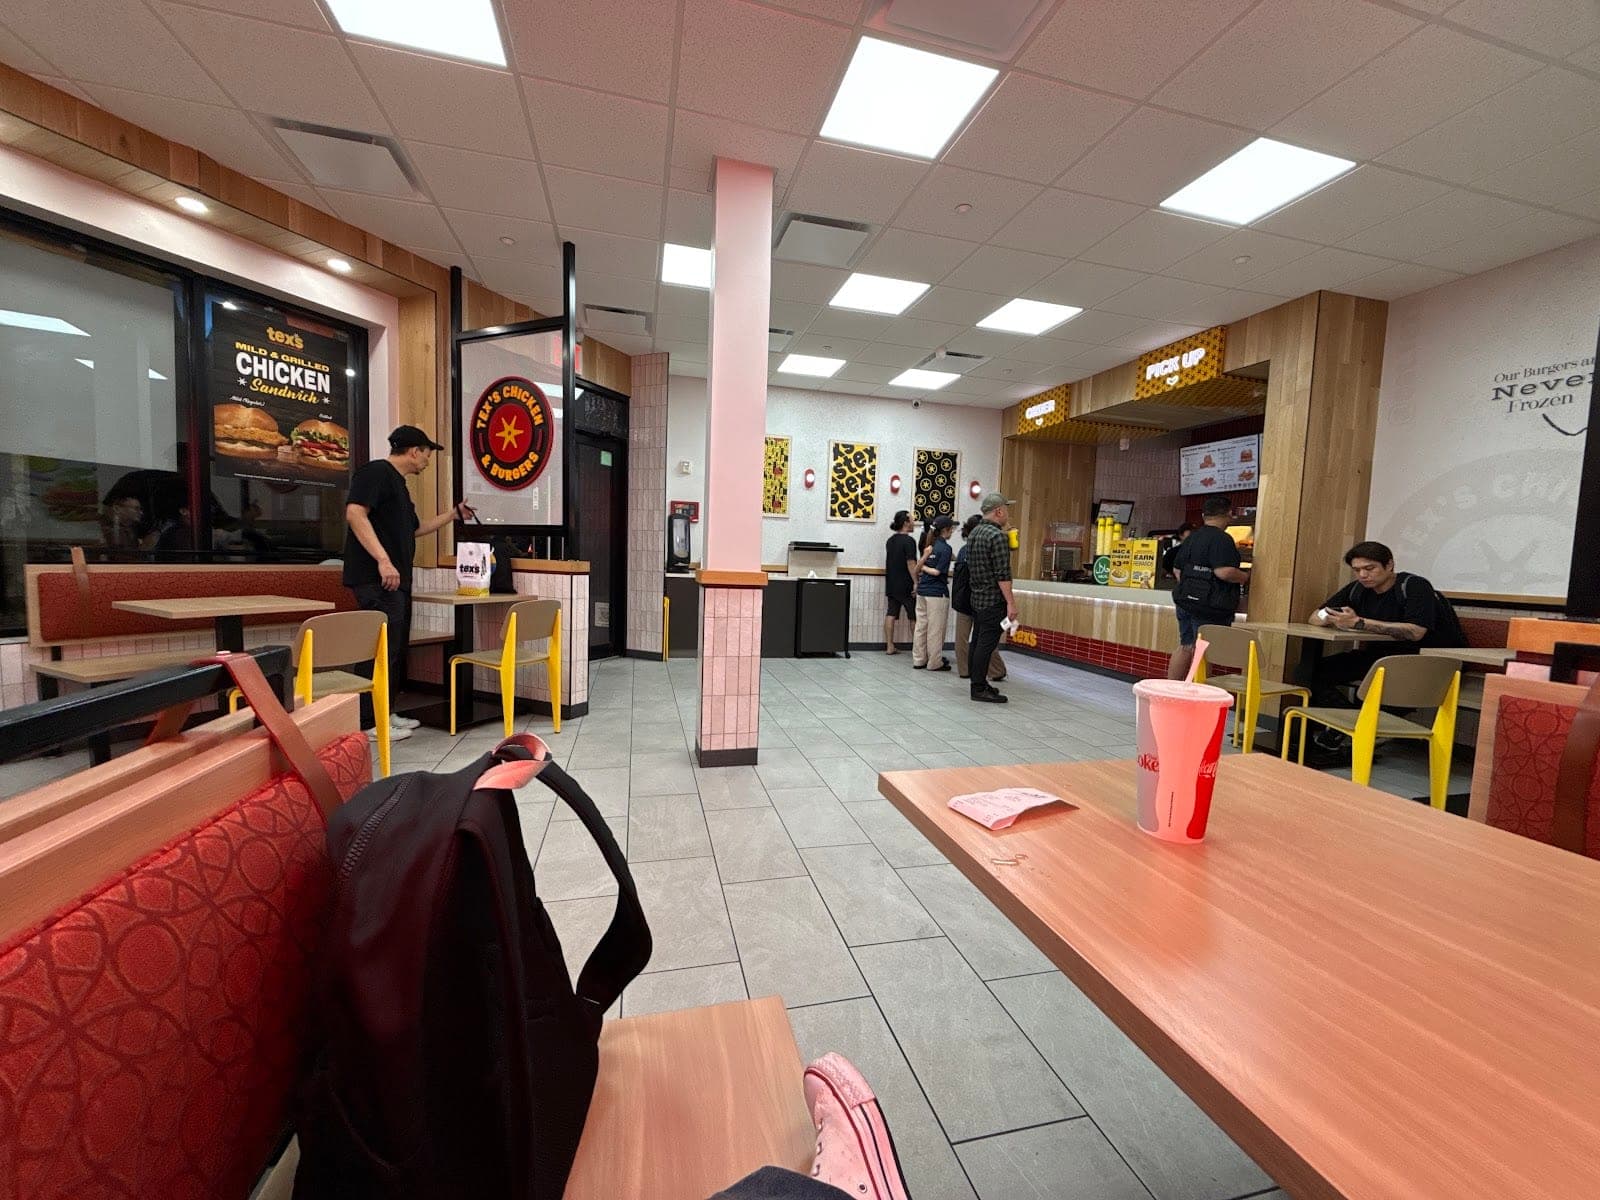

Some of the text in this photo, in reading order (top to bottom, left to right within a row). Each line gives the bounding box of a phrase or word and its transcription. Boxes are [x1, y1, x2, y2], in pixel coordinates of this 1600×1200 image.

[235, 341, 330, 373] MILD & GRILLED
[1146, 348, 1206, 380] PICK UP
[1494, 371, 1520, 383] Our
[1523, 361, 1577, 378] Burgers
[236, 351, 331, 394] CHICKEN
[249, 377, 320, 404] Sandwich
[1507, 393, 1574, 413] Frozen
[476, 385, 544, 429] TEX'S CHICKEN
[481, 451, 539, 481] & BURGERS
[1137, 753, 1160, 773] oke
